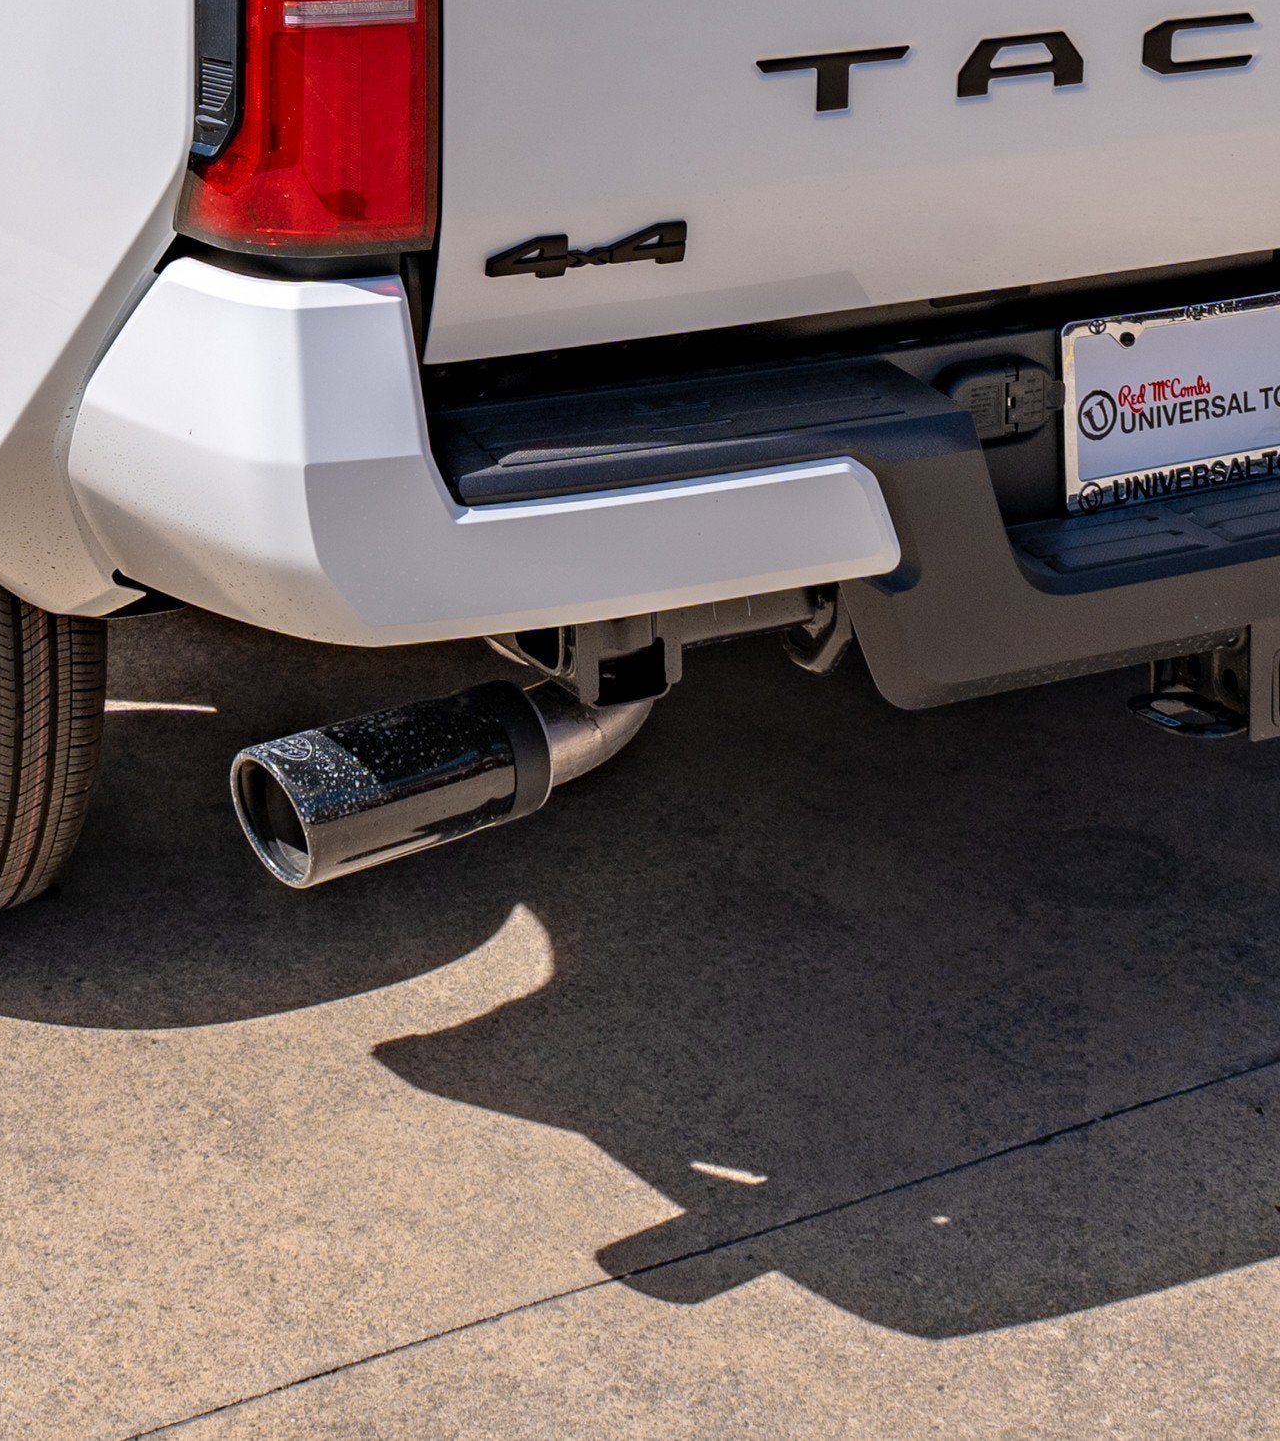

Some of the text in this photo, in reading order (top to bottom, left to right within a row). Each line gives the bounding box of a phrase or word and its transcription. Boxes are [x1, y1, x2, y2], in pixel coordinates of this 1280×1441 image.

[1118, 375, 1211, 413] Red McCombs
[1120, 391, 1256, 434] UNIVERSAL
[1112, 455, 1260, 504] UNIVERSAL
